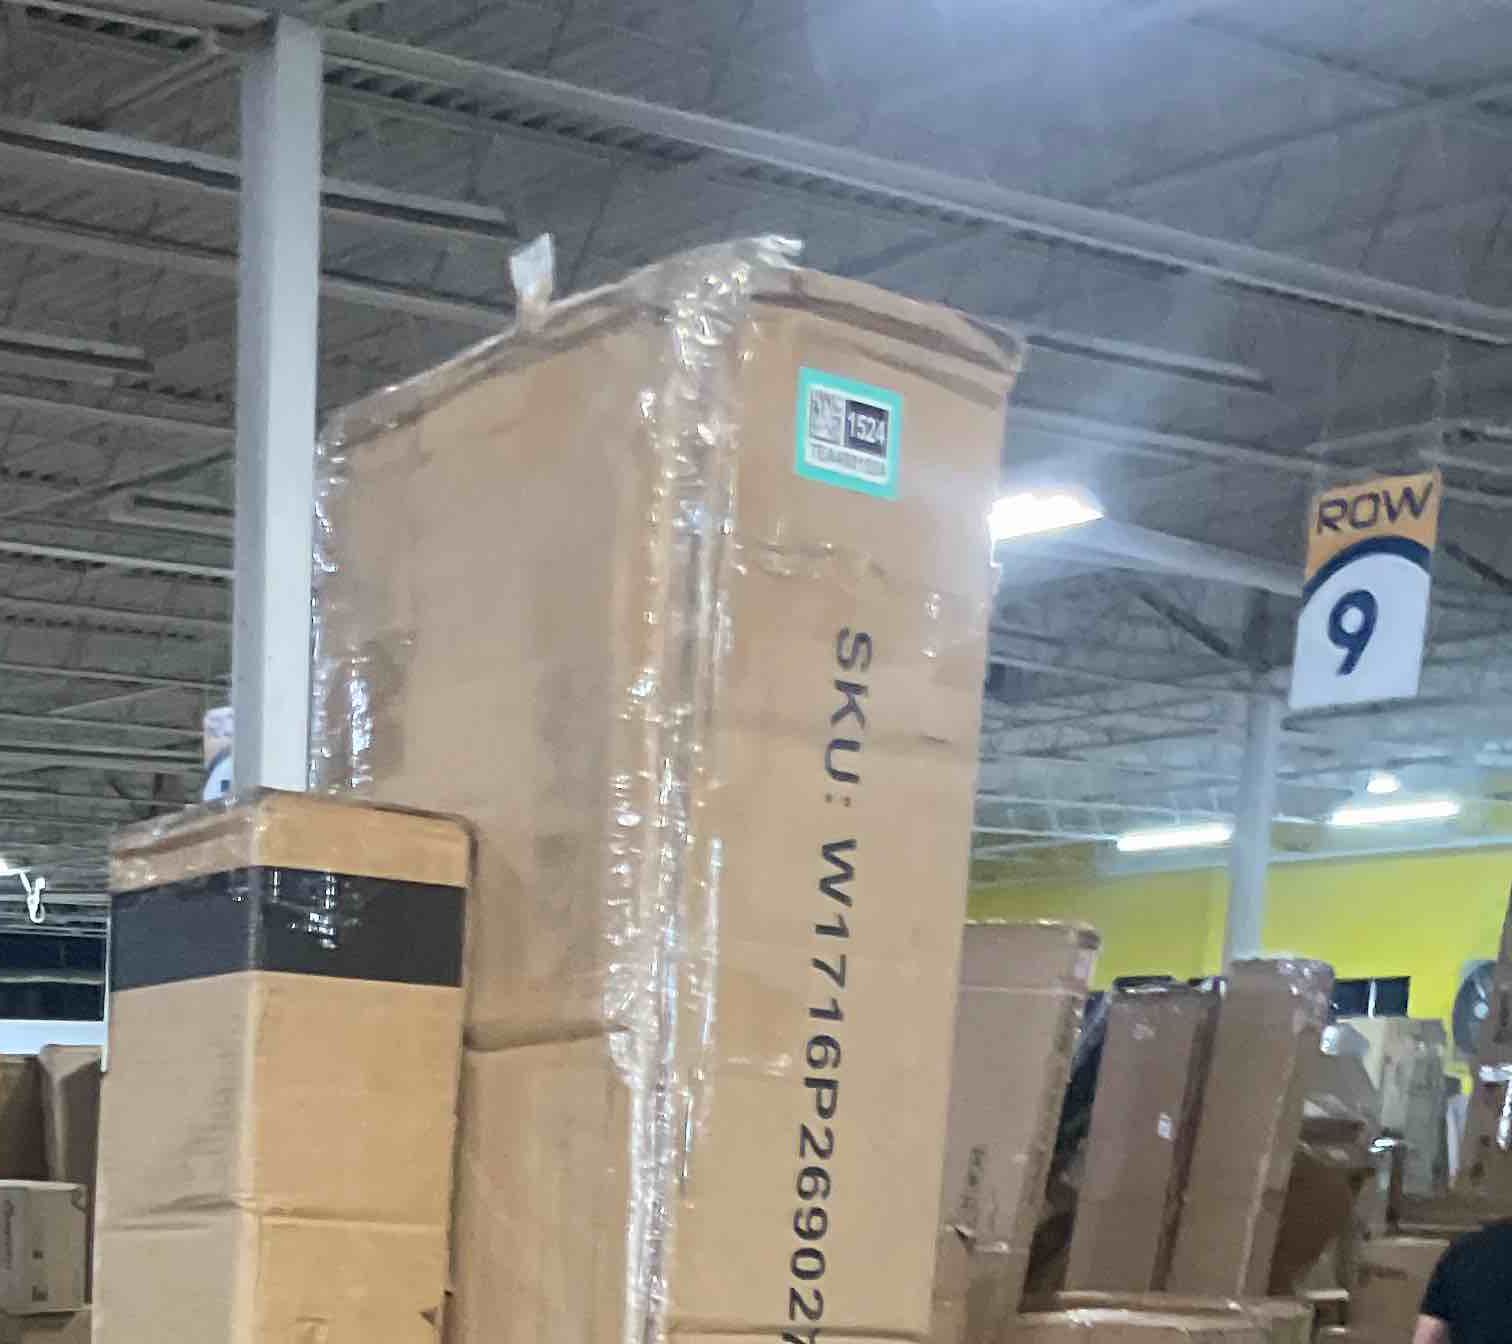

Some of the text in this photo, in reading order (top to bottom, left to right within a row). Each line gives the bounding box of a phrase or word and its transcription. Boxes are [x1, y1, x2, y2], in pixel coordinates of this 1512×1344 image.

[848, 411, 886, 444] 1524
[1316, 480, 1433, 535] ROW
[1327, 589, 1379, 676] 9
[823, 626, 873, 808] SKU:
